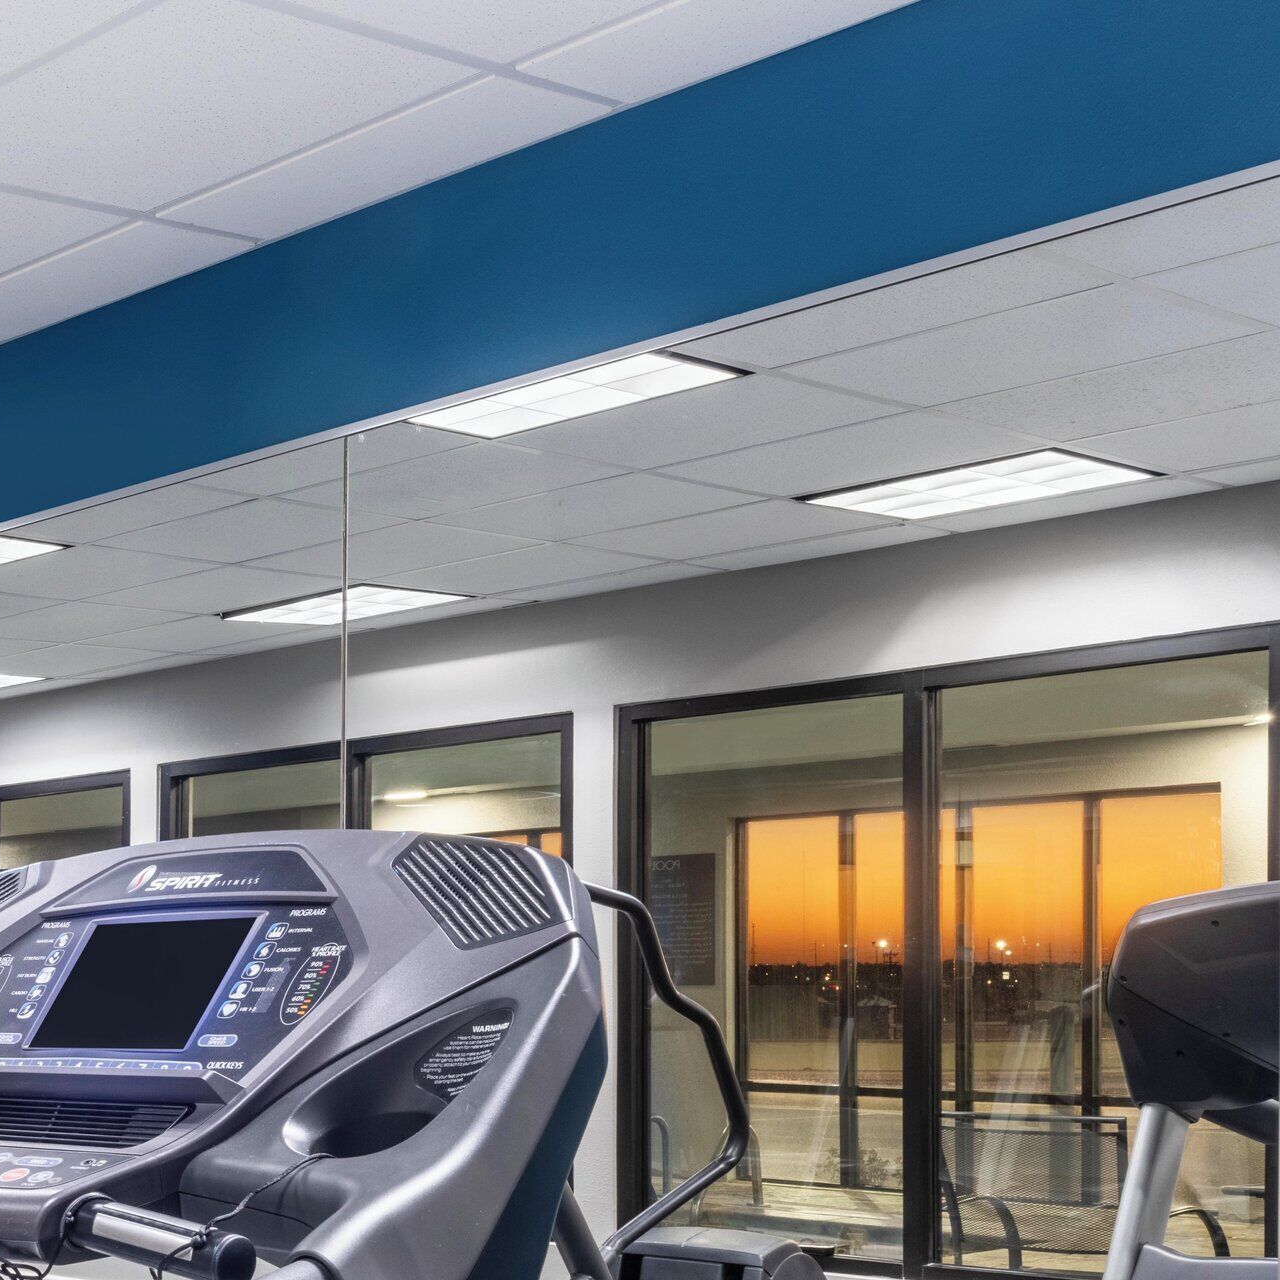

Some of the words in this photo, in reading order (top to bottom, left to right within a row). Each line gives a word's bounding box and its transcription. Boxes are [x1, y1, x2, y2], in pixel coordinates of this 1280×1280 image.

[145, 874, 223, 891] SPIRIT
[215, 878, 260, 887] FITNESS
[290, 908, 327, 917] PROGRAMS
[41, 921, 71, 929] PROGRAMS
[472, 1022, 510, 1032] WARNING!
